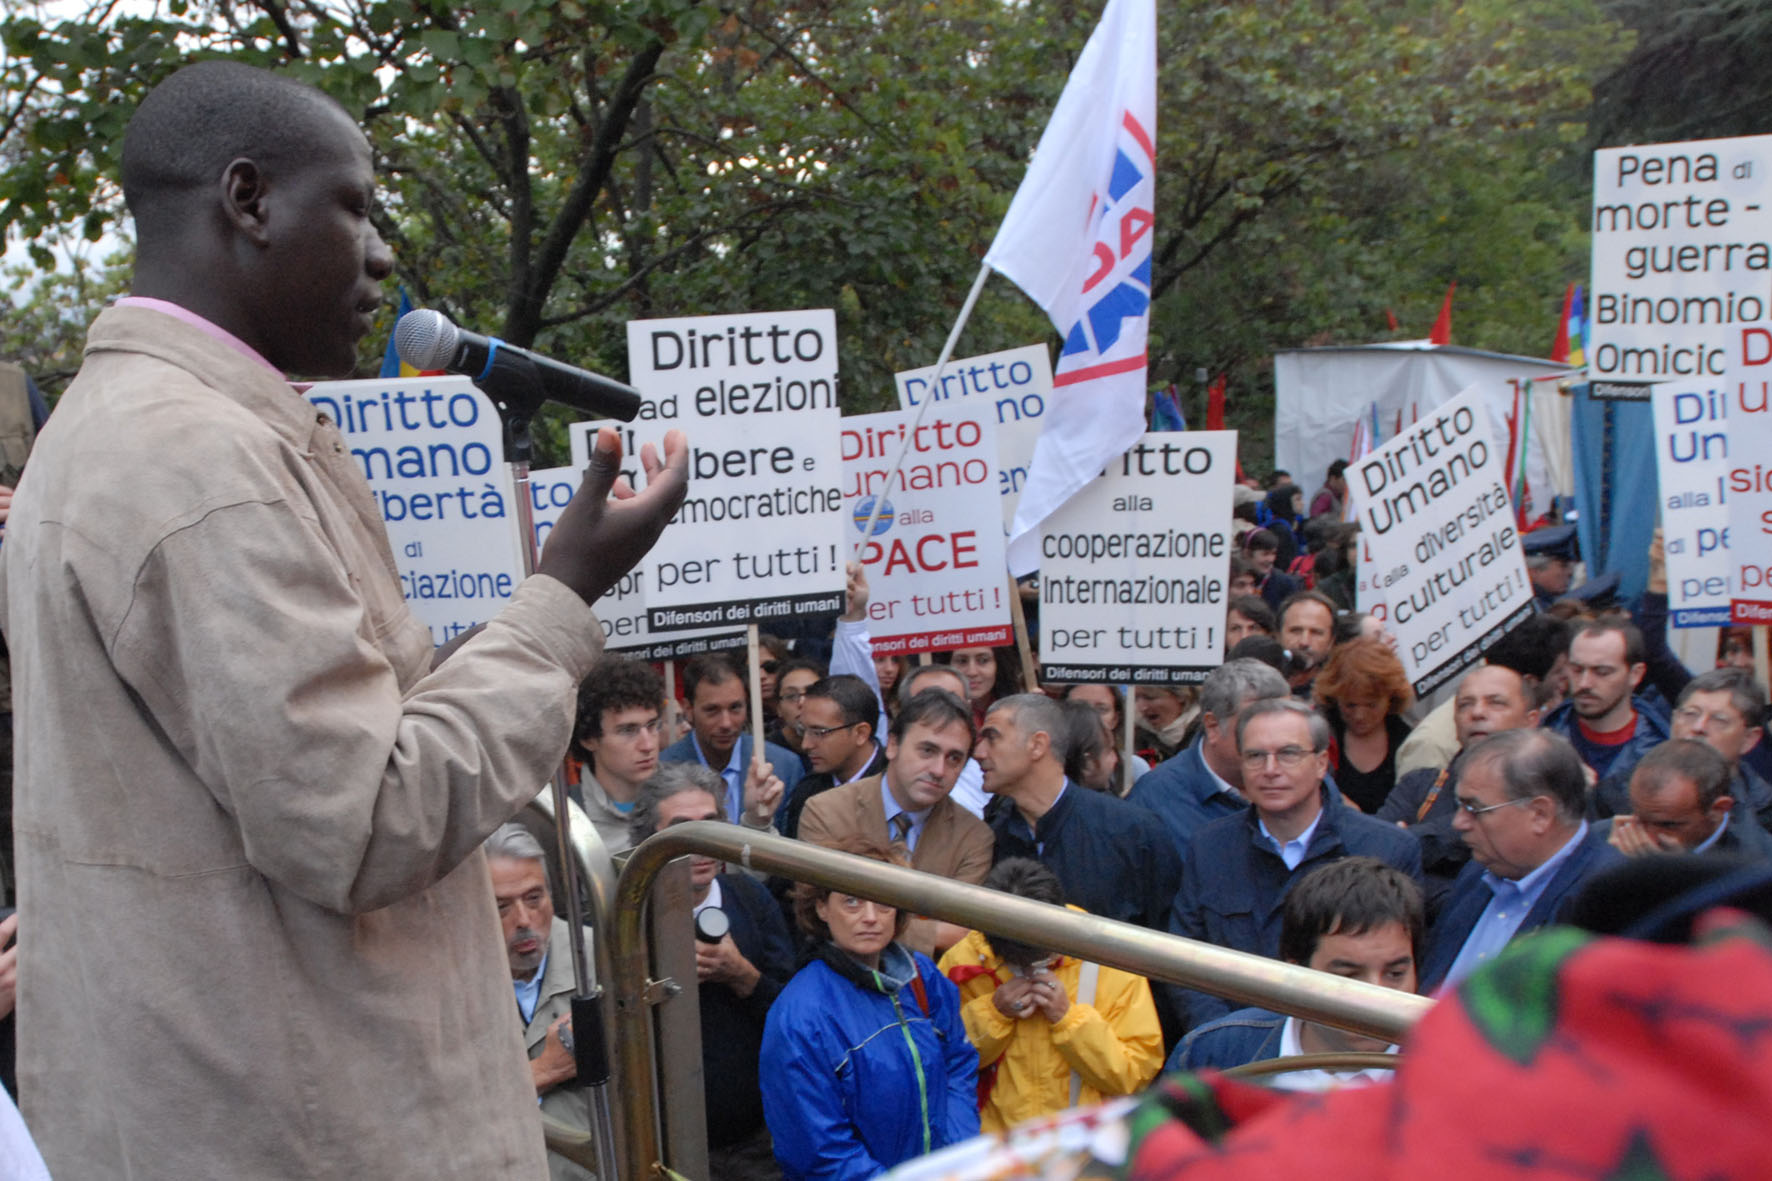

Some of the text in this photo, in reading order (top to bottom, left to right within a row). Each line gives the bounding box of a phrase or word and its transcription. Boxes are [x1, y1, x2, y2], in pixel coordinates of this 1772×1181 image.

[1617, 153, 1752, 188] Pena di
[1595, 195, 1730, 232] morte
[1625, 242, 1771, 279] guerra
[1597, 292, 1763, 325] Binomio
[651, 324, 824, 371] Diritto
[639, 373, 841, 420] ad elezioni
[351, 442, 492, 480] mano
[693, 445, 816, 480] bere e
[1361, 406, 1473, 497] Diritto
[373, 483, 506, 522] bertà
[667, 485, 842, 525] mocratiche
[1112, 495, 1154, 512] alla
[1368, 440, 1488, 535] Umano
[1667, 491, 1711, 509] alla
[899, 508, 935, 527] alla
[1384, 565, 1409, 588] alla
[1415, 482, 1508, 564] diversità
[404, 541, 423, 558] di
[1042, 529, 1225, 564] cooperazione
[657, 558, 721, 592] per
[732, 545, 818, 580] tutti
[1394, 526, 1516, 624] culturale
[868, 599, 902, 621] er
[911, 588, 985, 617] tutti
[1044, 575, 1222, 604] Internazionale
[653, 596, 841, 627] Difensori dei diritti umani
[653, 645, 674, 658] dei
[675, 639, 708, 656] diritti
[709, 634, 749, 650] umani
[909, 635, 929, 650] dei
[931, 631, 964, 647] diritti
[967, 628, 1007, 644] umani
[1051, 629, 1107, 651] per
[1117, 626, 1196, 649] tutti
[1412, 622, 1452, 668] per
[1046, 667, 1106, 681] Difensori
[1109, 667, 1130, 681] dei
[1133, 668, 1168, 681] diritti
